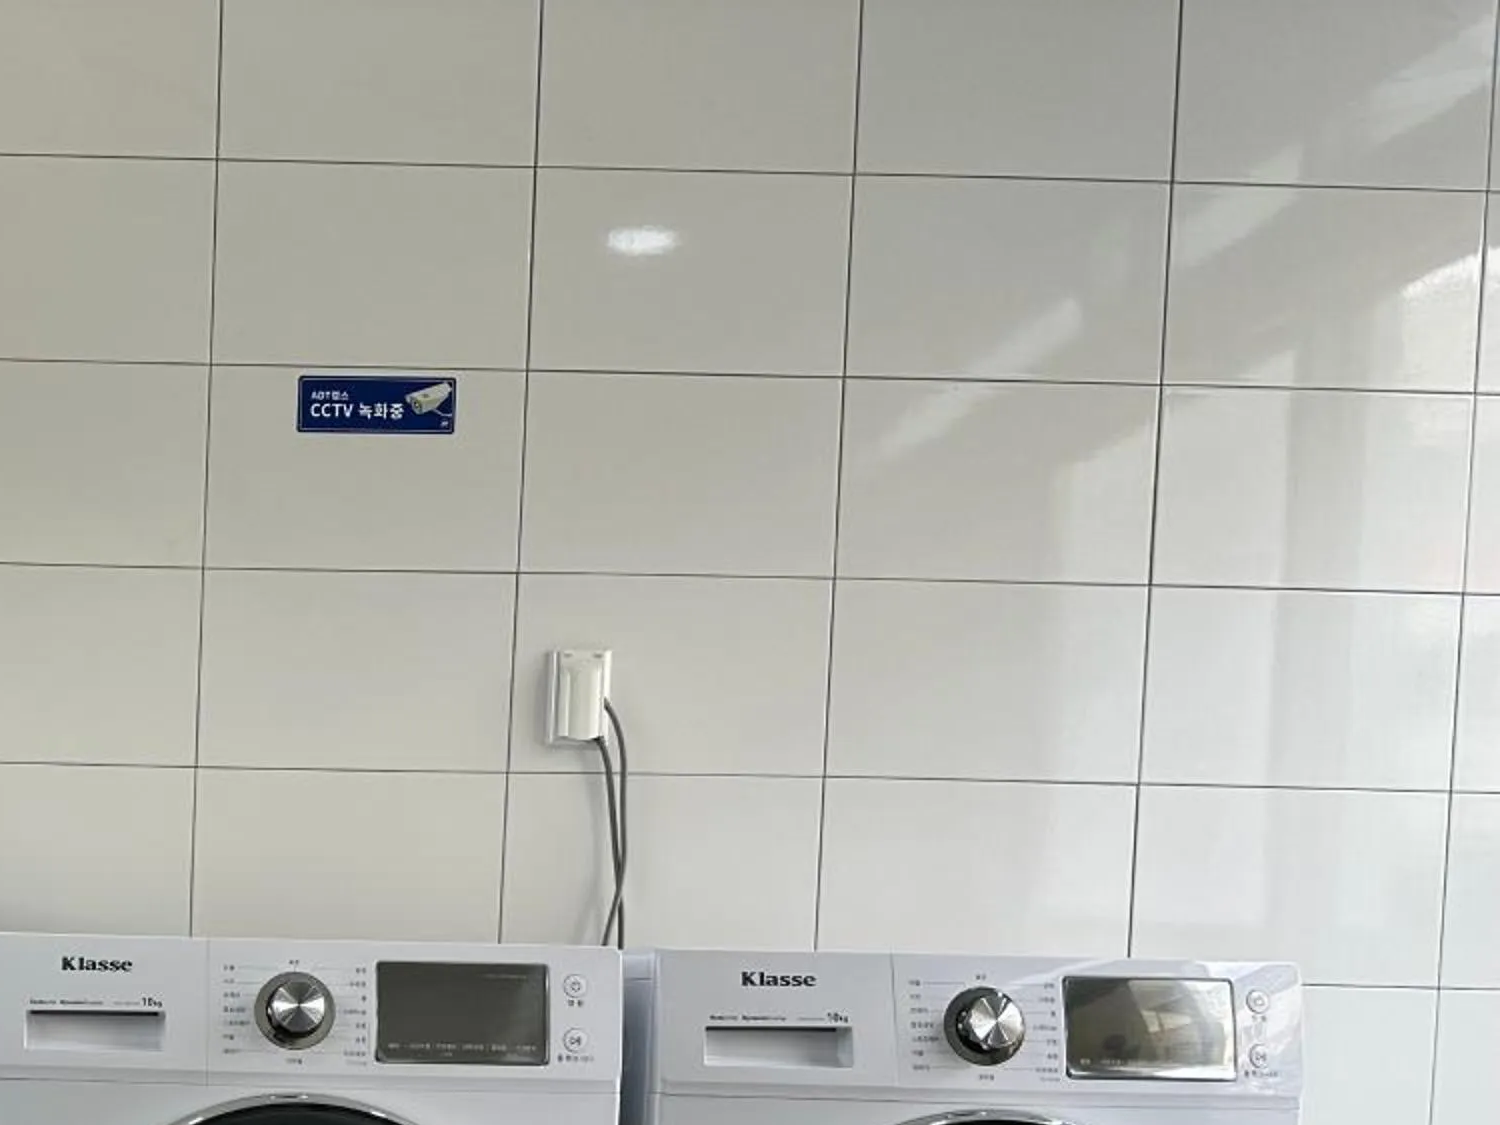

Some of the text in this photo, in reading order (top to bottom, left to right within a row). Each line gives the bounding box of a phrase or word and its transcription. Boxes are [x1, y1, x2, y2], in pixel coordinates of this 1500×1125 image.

[310, 402, 404, 420] CCTV 녹화중
[61, 956, 133, 972] Klasse
[741, 971, 817, 987] Klasse
